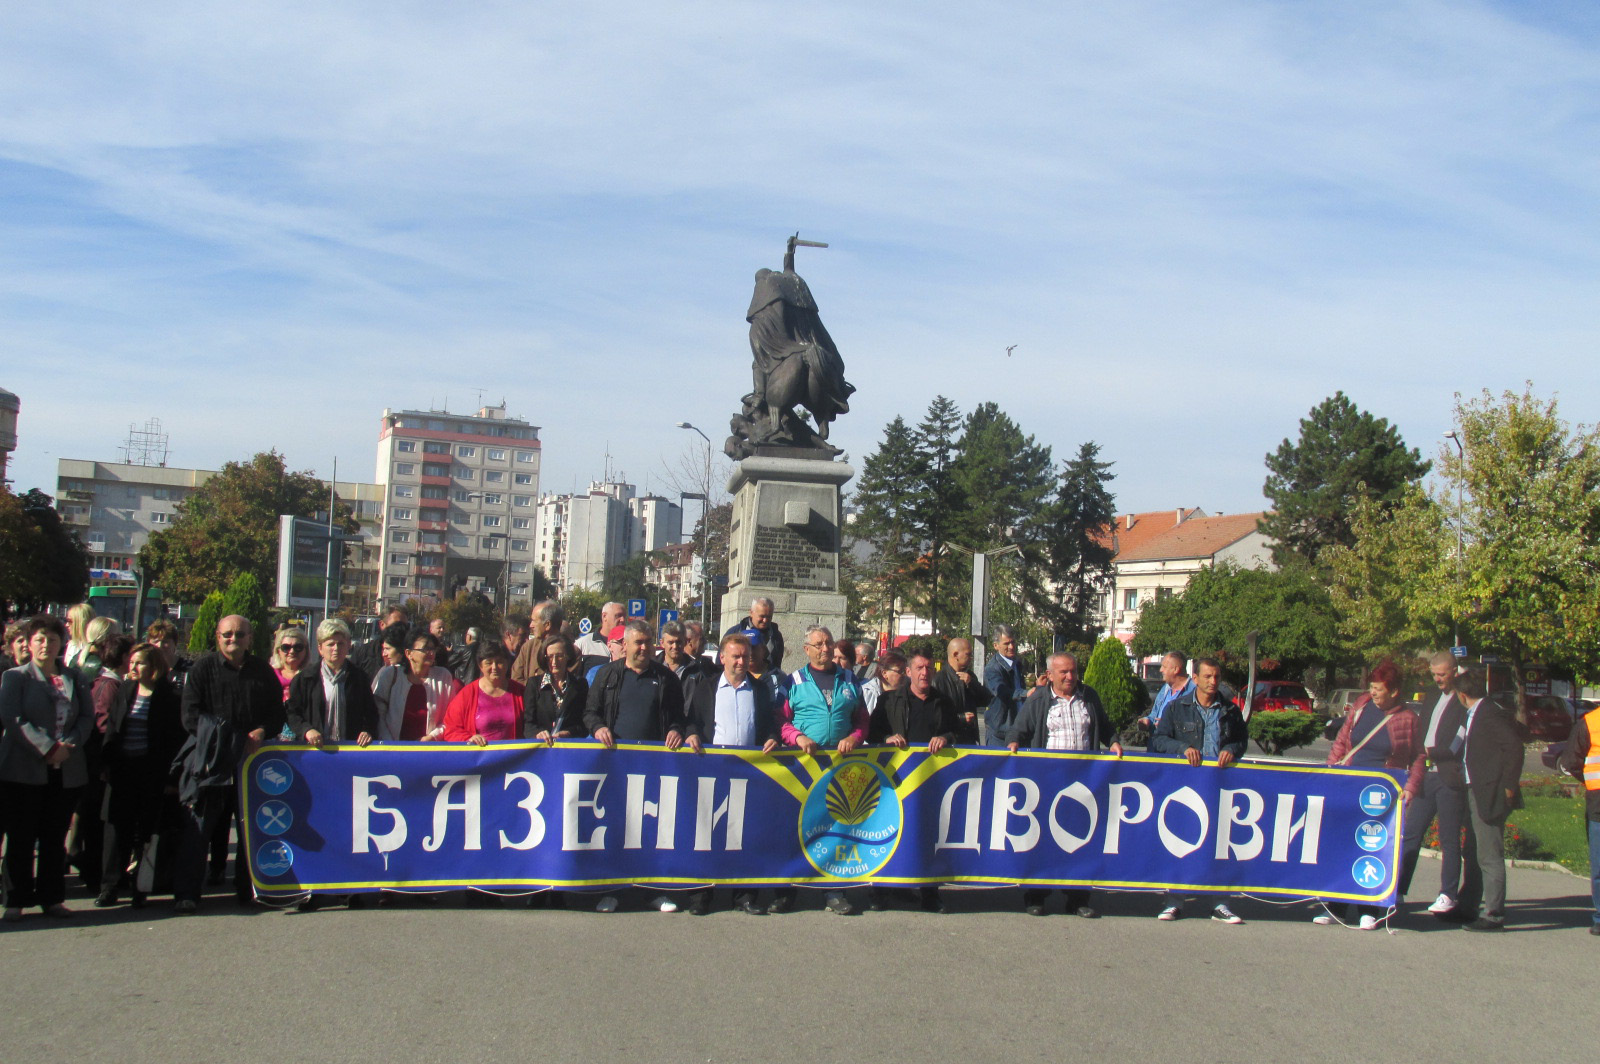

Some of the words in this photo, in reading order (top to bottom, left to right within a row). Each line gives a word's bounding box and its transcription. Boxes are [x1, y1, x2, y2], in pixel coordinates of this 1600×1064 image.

[632, 602, 641, 614] P
[351, 771, 749, 870] БАЗЕНИ
[934, 777, 1326, 865] ДВОРОВИ
[850, 824, 896, 839] ДВОРОВИ
[836, 844, 862, 864] БД
[822, 862, 869, 875] ДВОРОВИ
